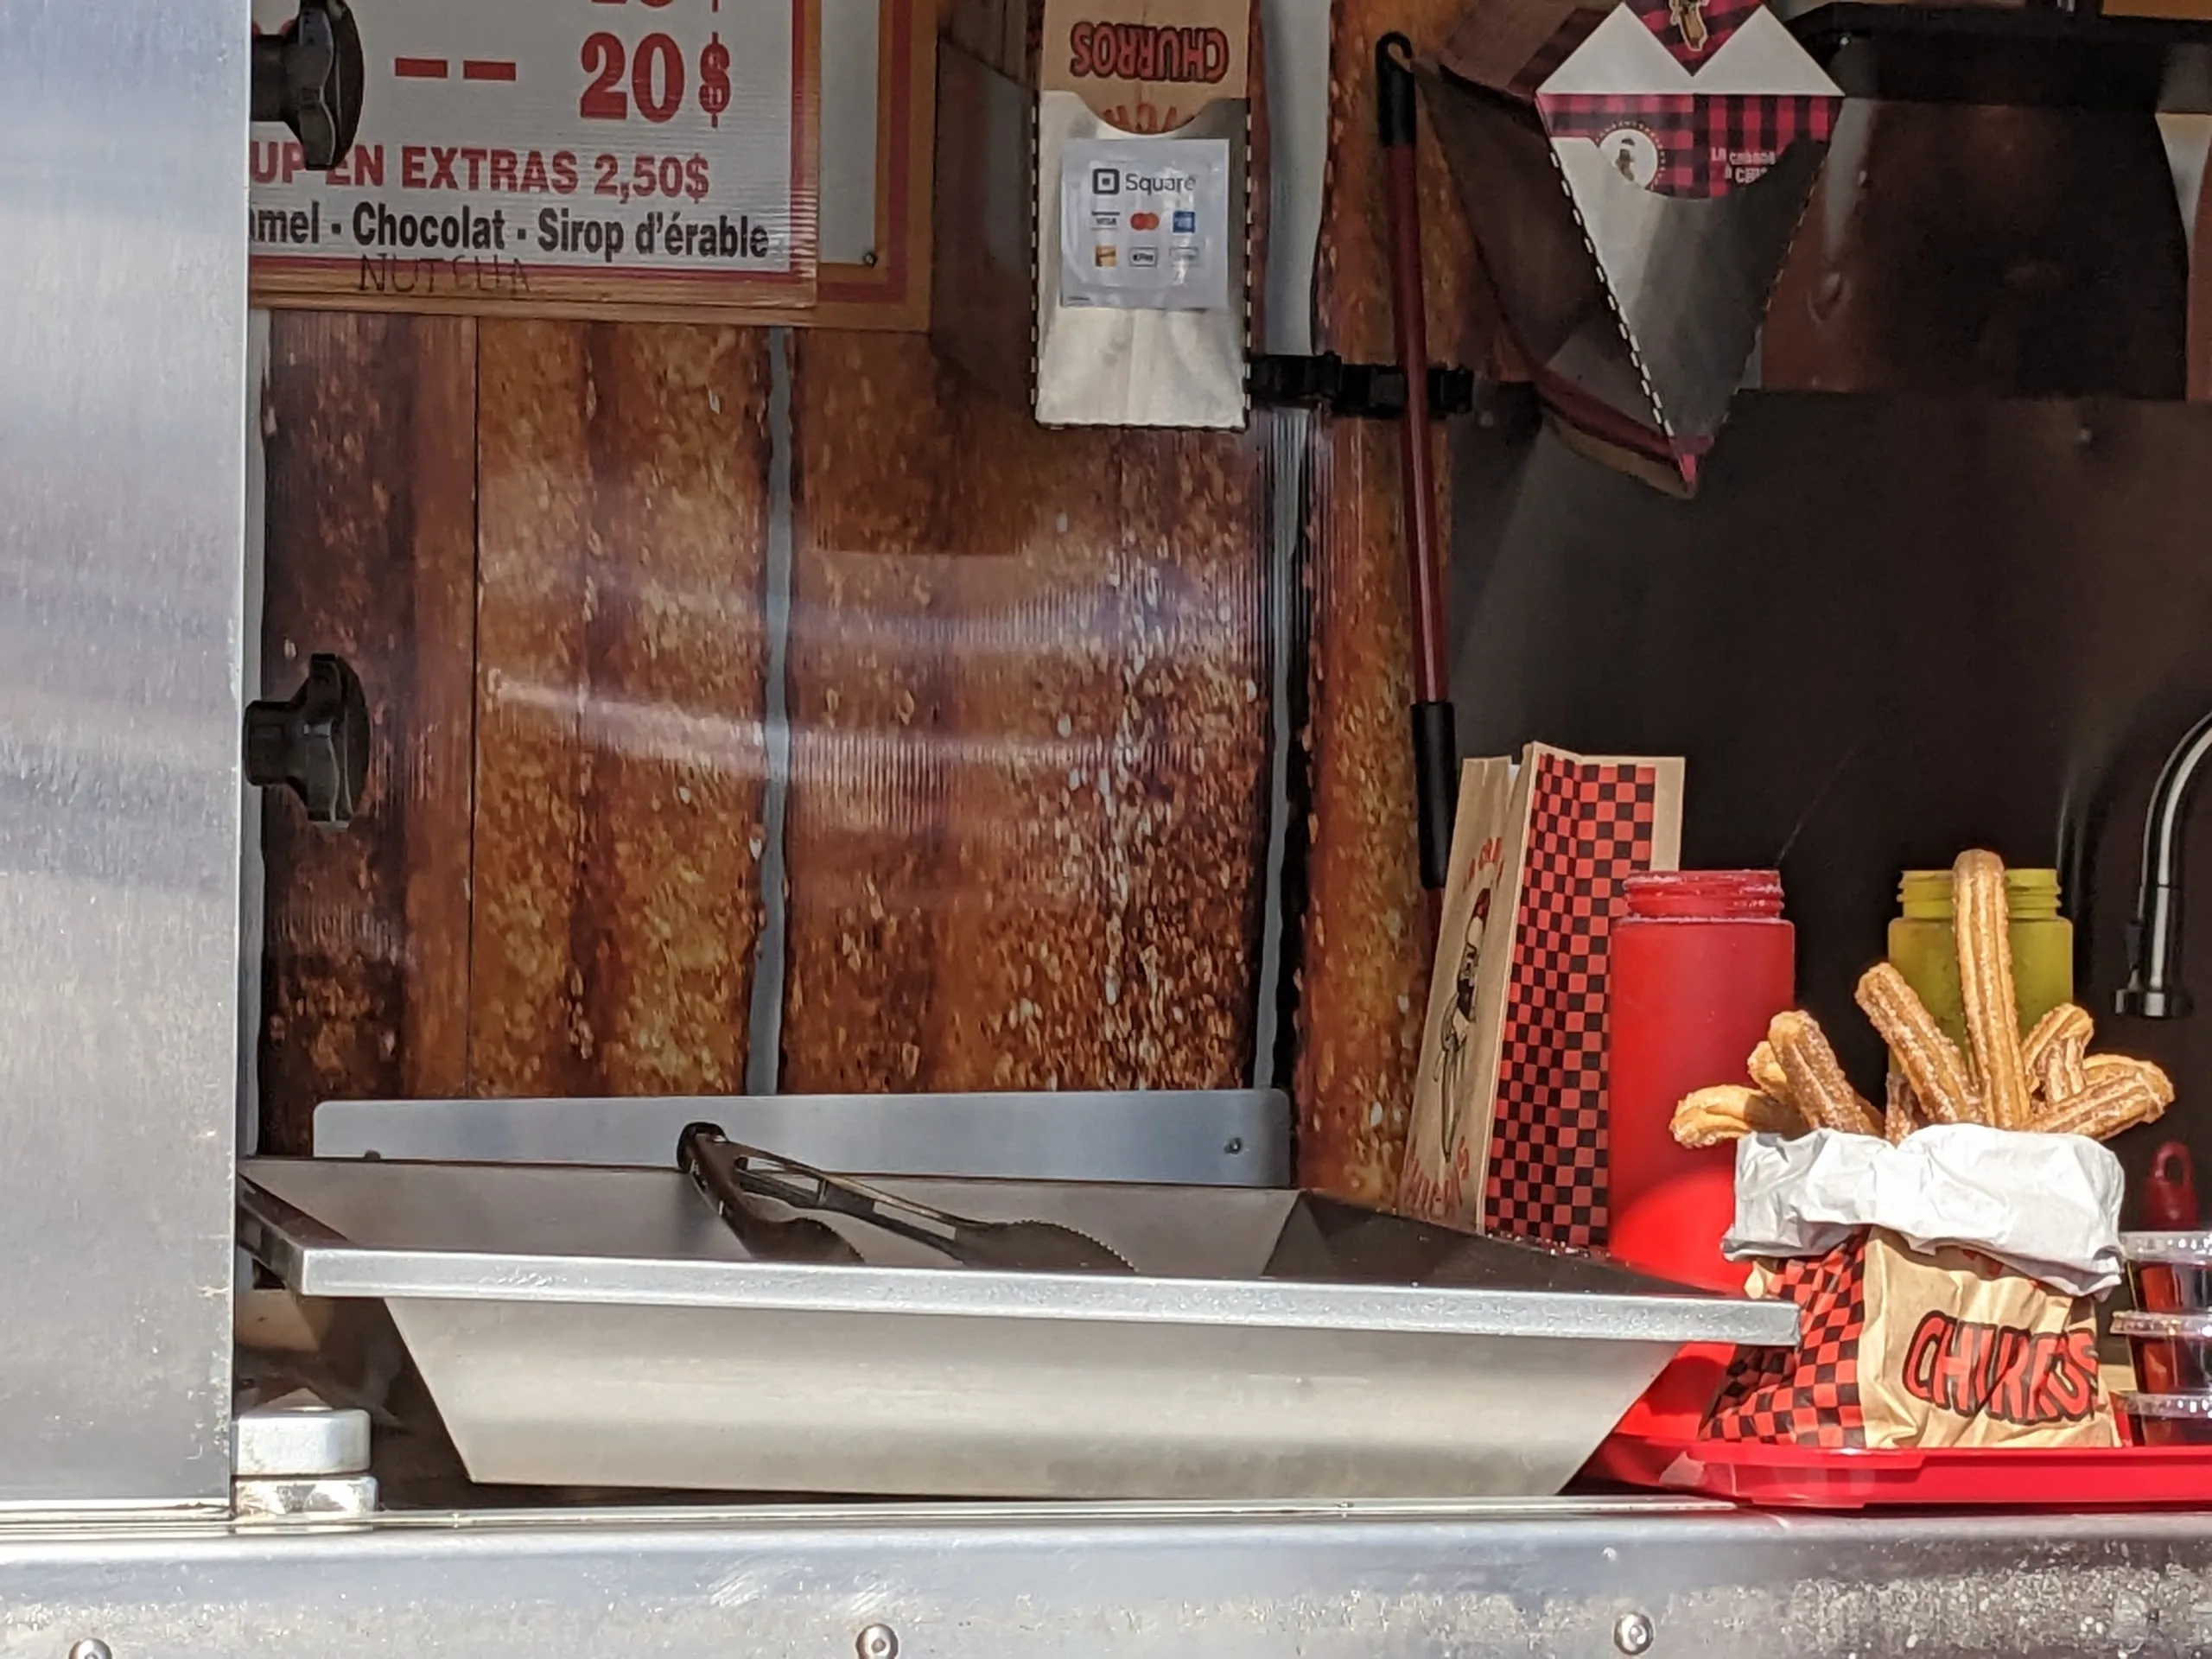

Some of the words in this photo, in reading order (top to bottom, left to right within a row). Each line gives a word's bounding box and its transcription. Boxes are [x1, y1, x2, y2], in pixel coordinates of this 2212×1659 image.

[1069, 20, 1230, 84] CHURROS
[402, 145, 579, 195] EXTRAS
[593, 152, 709, 204] 2,50$
[1125, 173, 1197, 196] Square
[353, 201, 505, 251] Chocolat
[537, 207, 625, 263] Sirop
